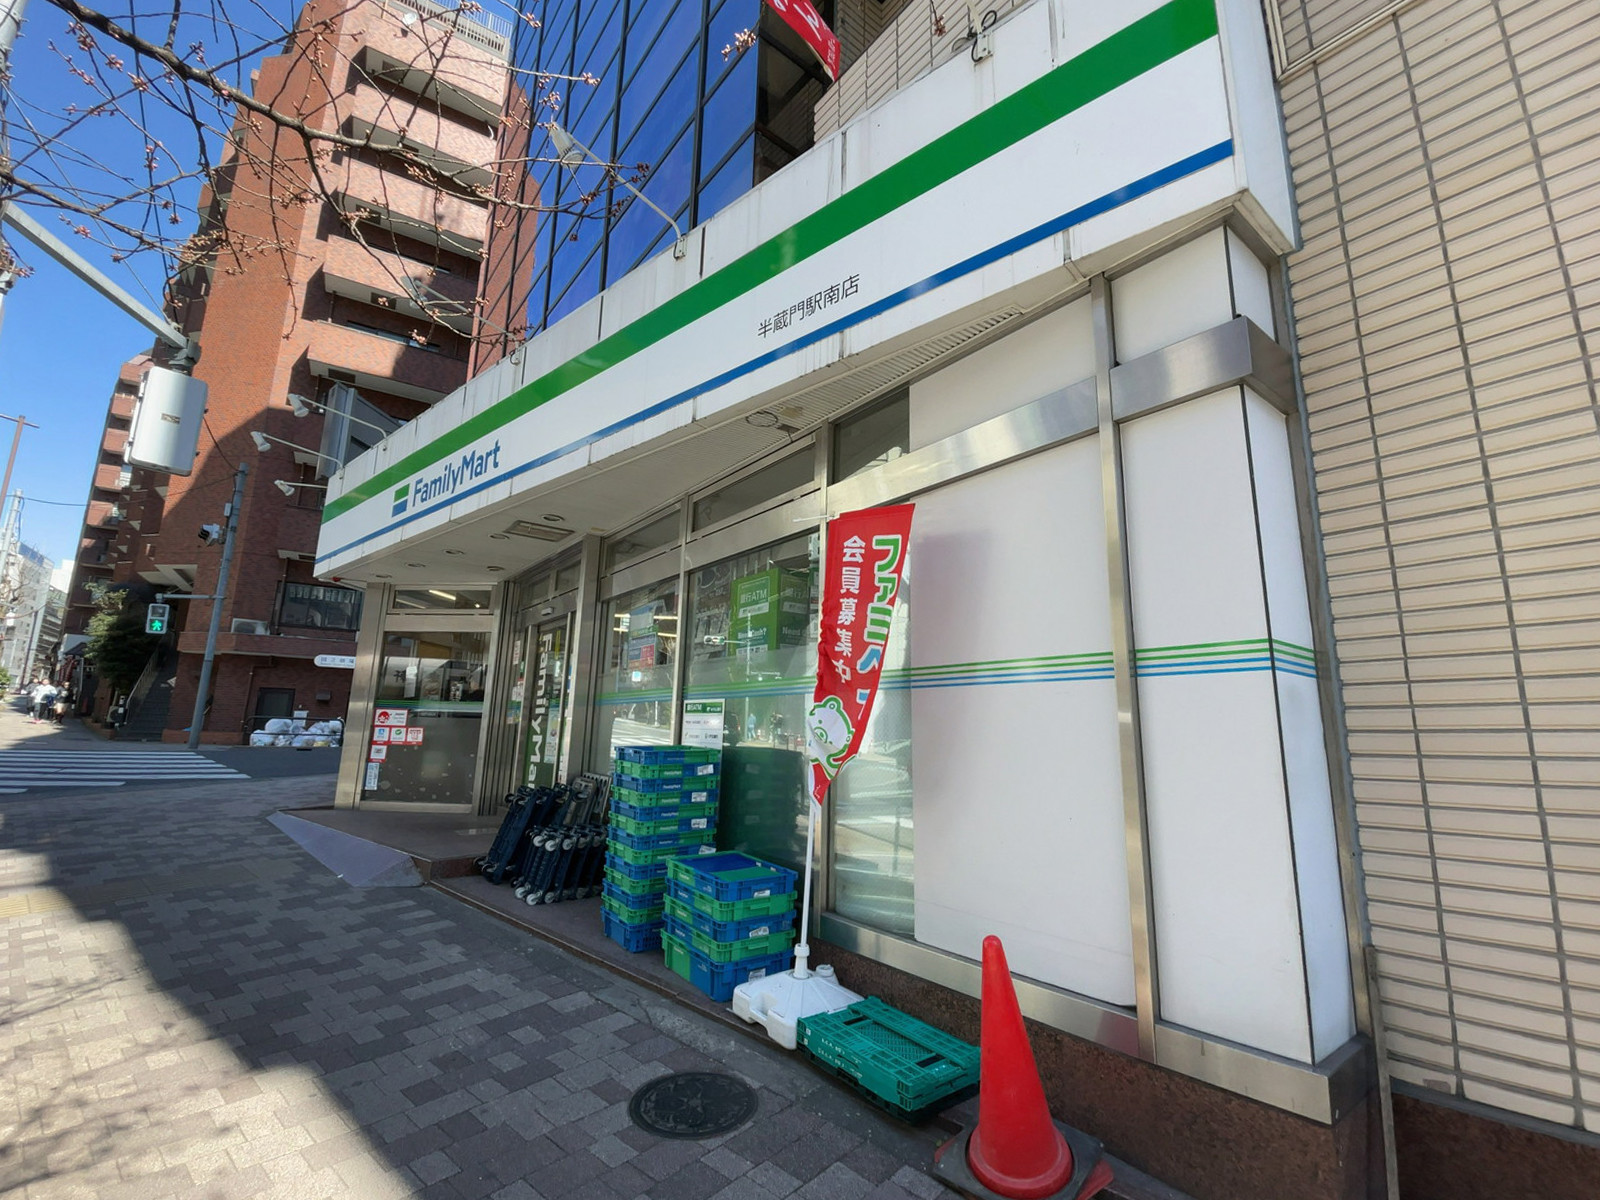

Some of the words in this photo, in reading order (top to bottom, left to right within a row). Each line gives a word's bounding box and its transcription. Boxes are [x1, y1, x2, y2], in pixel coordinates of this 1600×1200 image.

[758, 274, 860, 338] 半蔵門駅南店
[412, 439, 500, 507] FamilyMart
